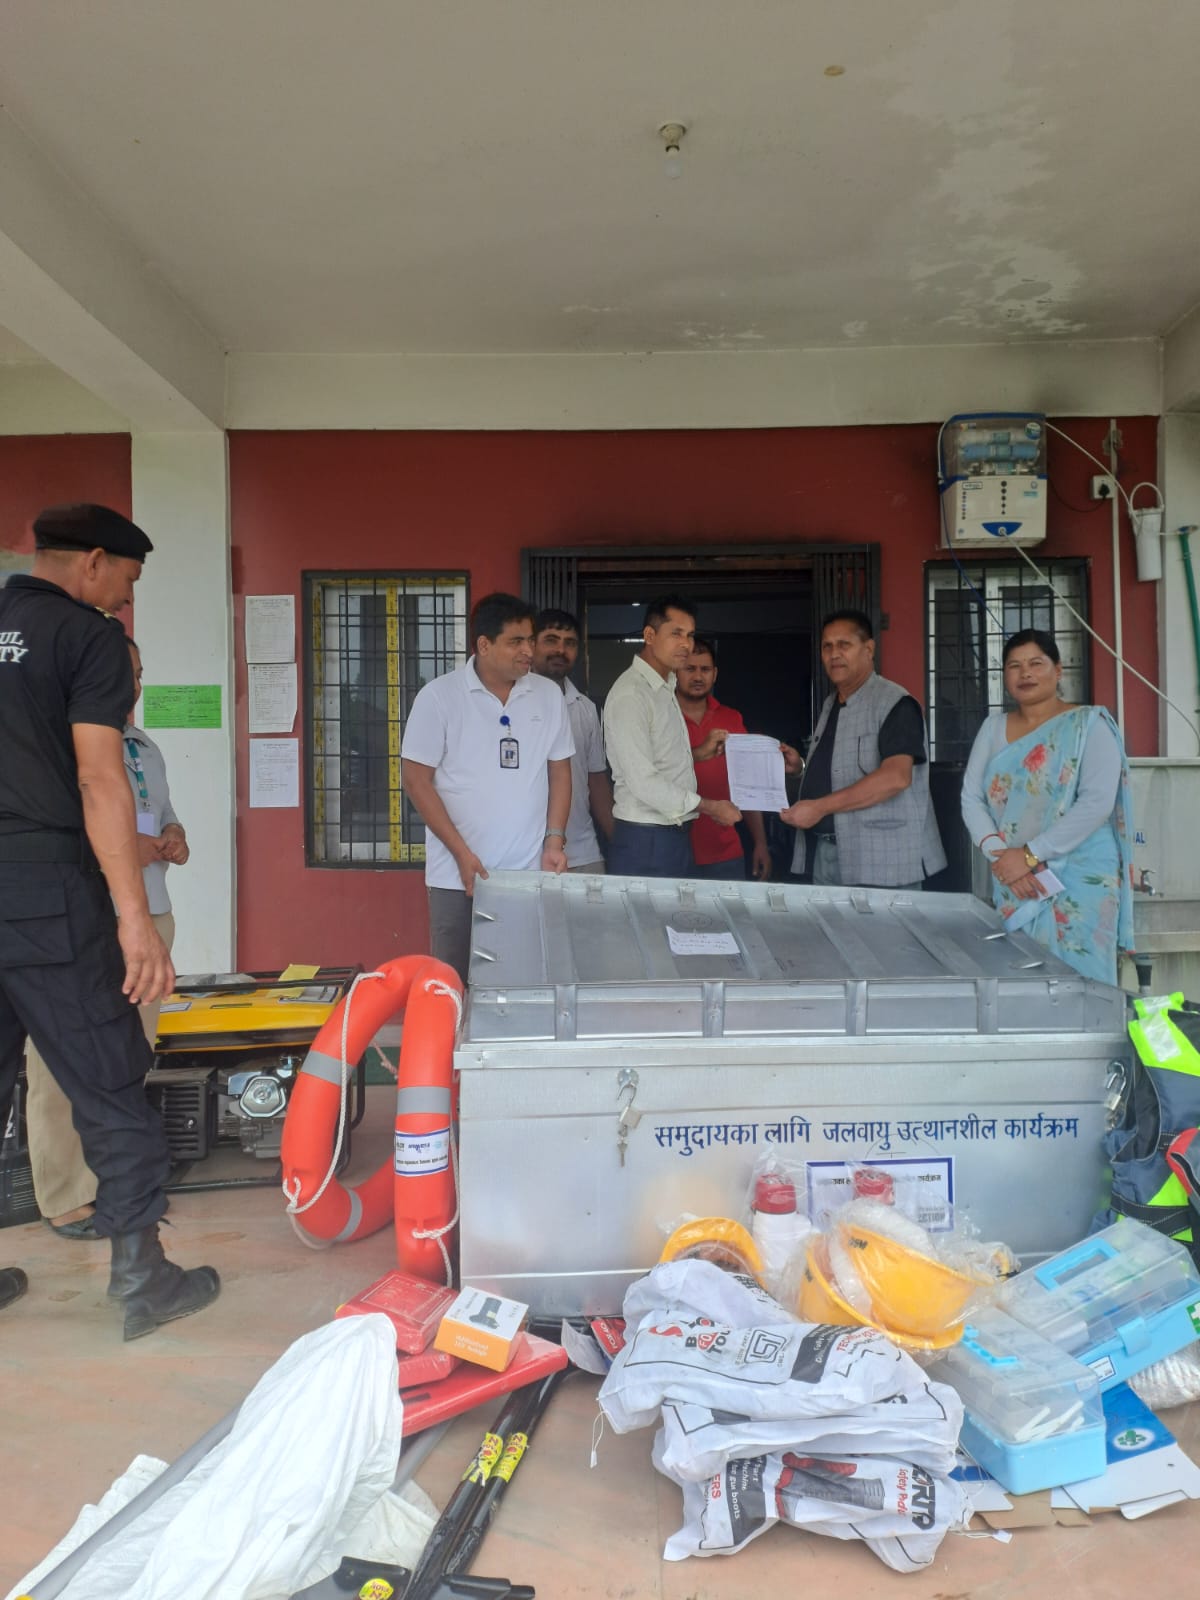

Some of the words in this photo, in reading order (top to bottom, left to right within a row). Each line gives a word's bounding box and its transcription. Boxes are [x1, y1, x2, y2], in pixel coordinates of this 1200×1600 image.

[654, 1123, 759, 1156] समुदायका
[764, 1115, 812, 1143] लागि
[822, 1121, 890, 1150] जलवायु
[897, 1113, 997, 1145] उत्थानशील
[1004, 1112, 1079, 1139] कार्यक्रम
